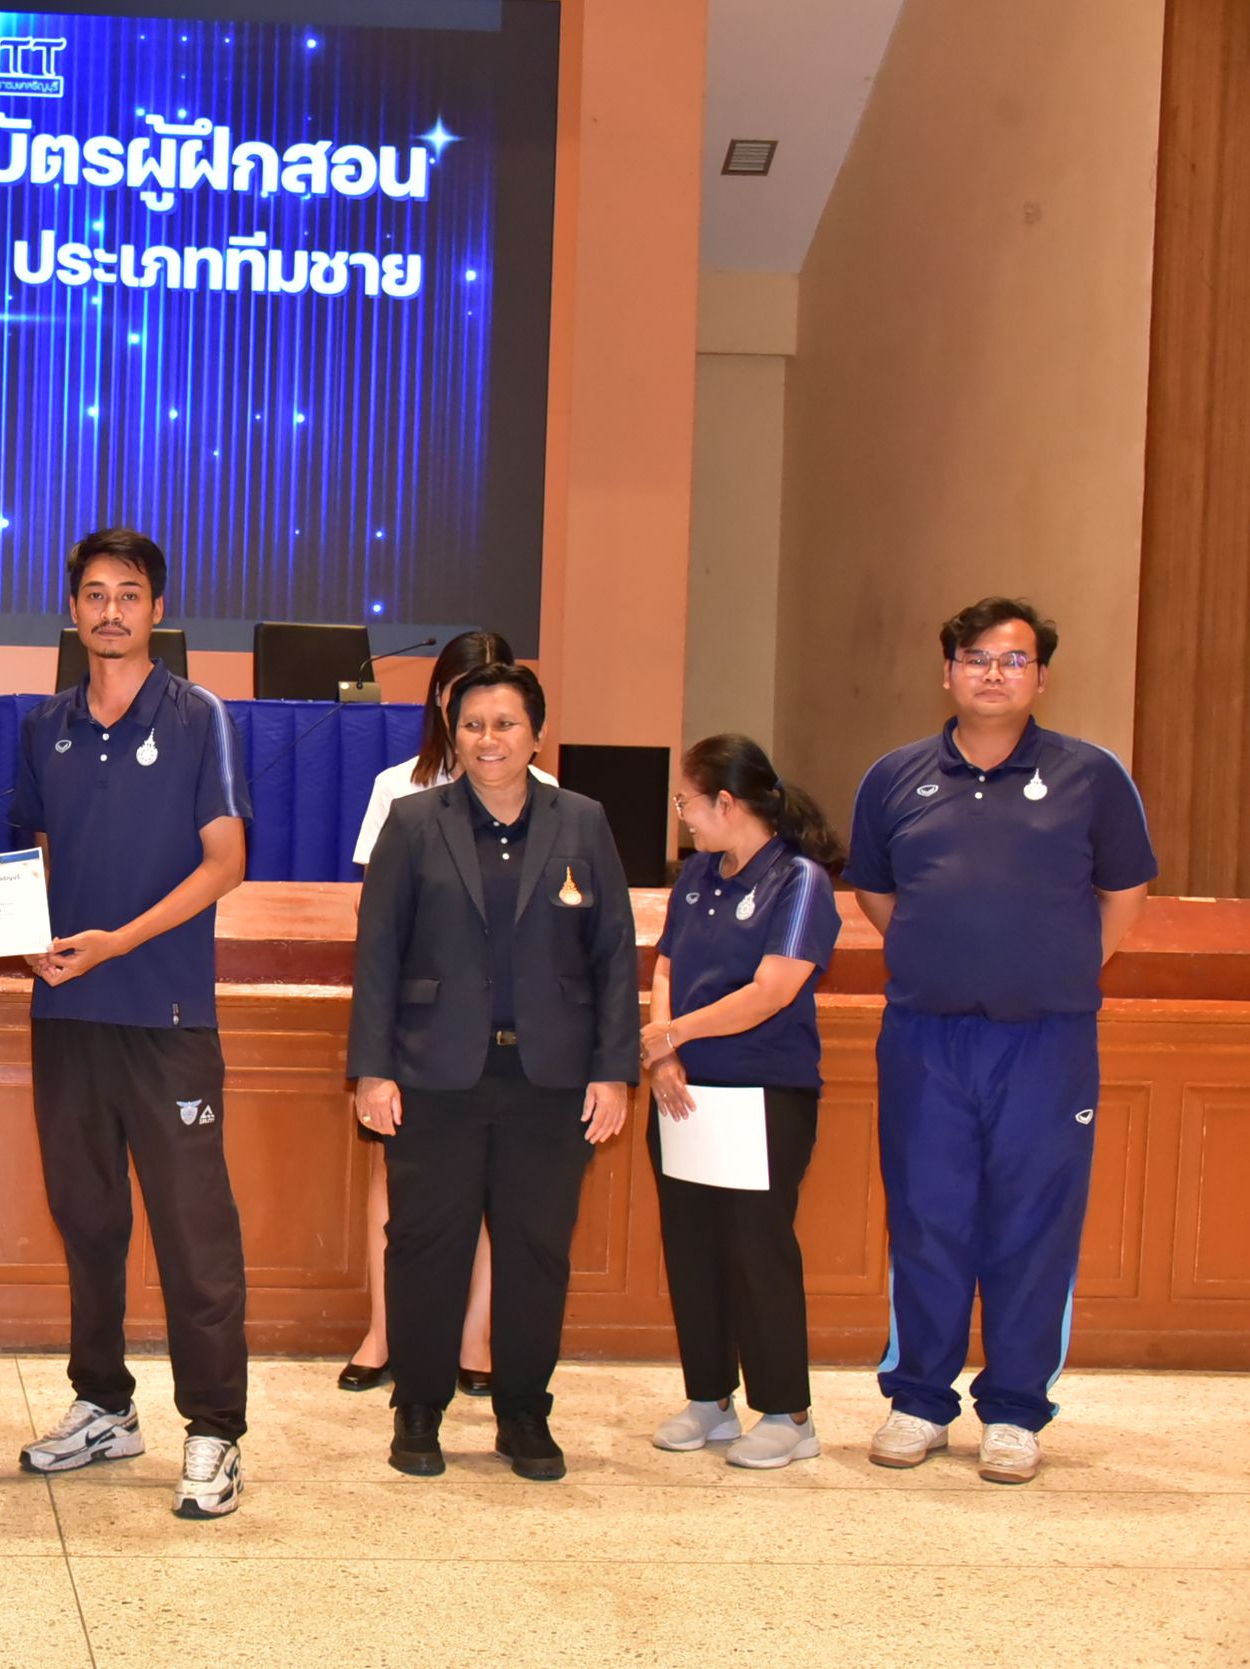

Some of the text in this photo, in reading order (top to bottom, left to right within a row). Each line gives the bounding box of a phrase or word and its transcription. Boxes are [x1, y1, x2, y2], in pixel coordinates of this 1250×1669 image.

[14, 230, 423, 298] ประเภททีมชาย
